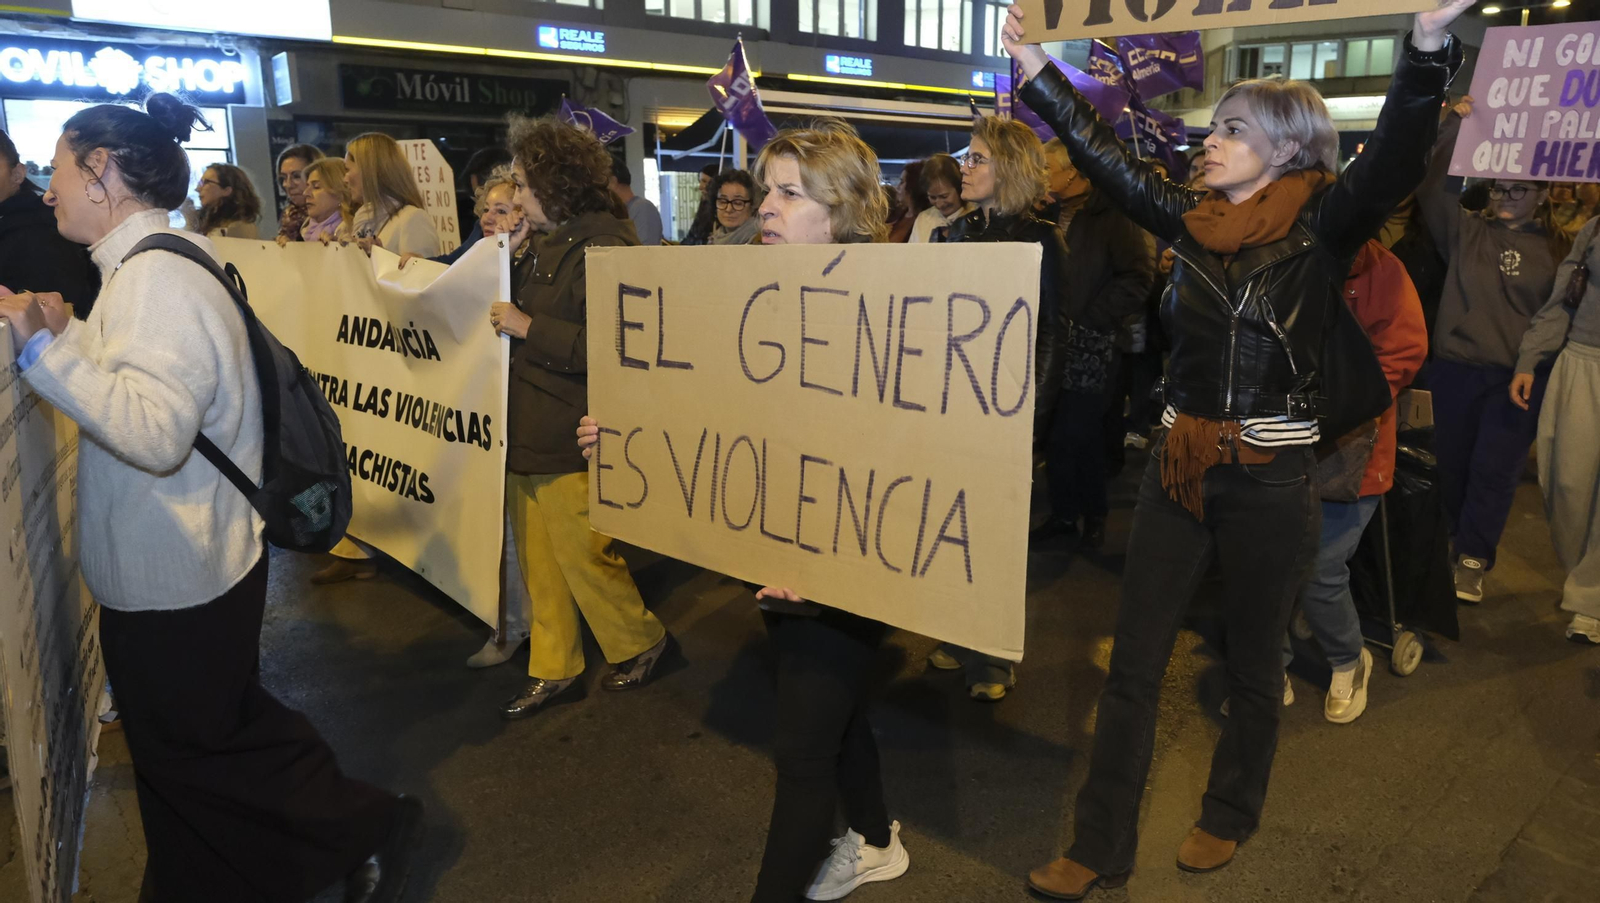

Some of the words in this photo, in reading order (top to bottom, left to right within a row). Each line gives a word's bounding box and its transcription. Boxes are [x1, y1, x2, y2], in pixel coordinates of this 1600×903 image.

[559, 28, 605, 44] REALE
[1503, 36, 1545, 68] NI
[144, 55, 244, 94] SHOP
[840, 56, 872, 69] REALE
[395, 72, 470, 103] Móvil
[477, 78, 538, 113] Shop
[1487, 74, 1551, 109] QUE
[1493, 111, 1529, 139] NI
[413, 143, 427, 161] TE
[1472, 140, 1523, 174] QUE
[439, 167, 445, 184] A
[436, 190, 451, 208] NO
[615, 282, 695, 371] EL
[738, 250, 1031, 417] GÉNERO
[352, 382, 392, 419] LAS
[395, 391, 492, 452] VIOLENCIAS
[596, 426, 649, 510] ES
[662, 427, 973, 584] VIOLENCIA
